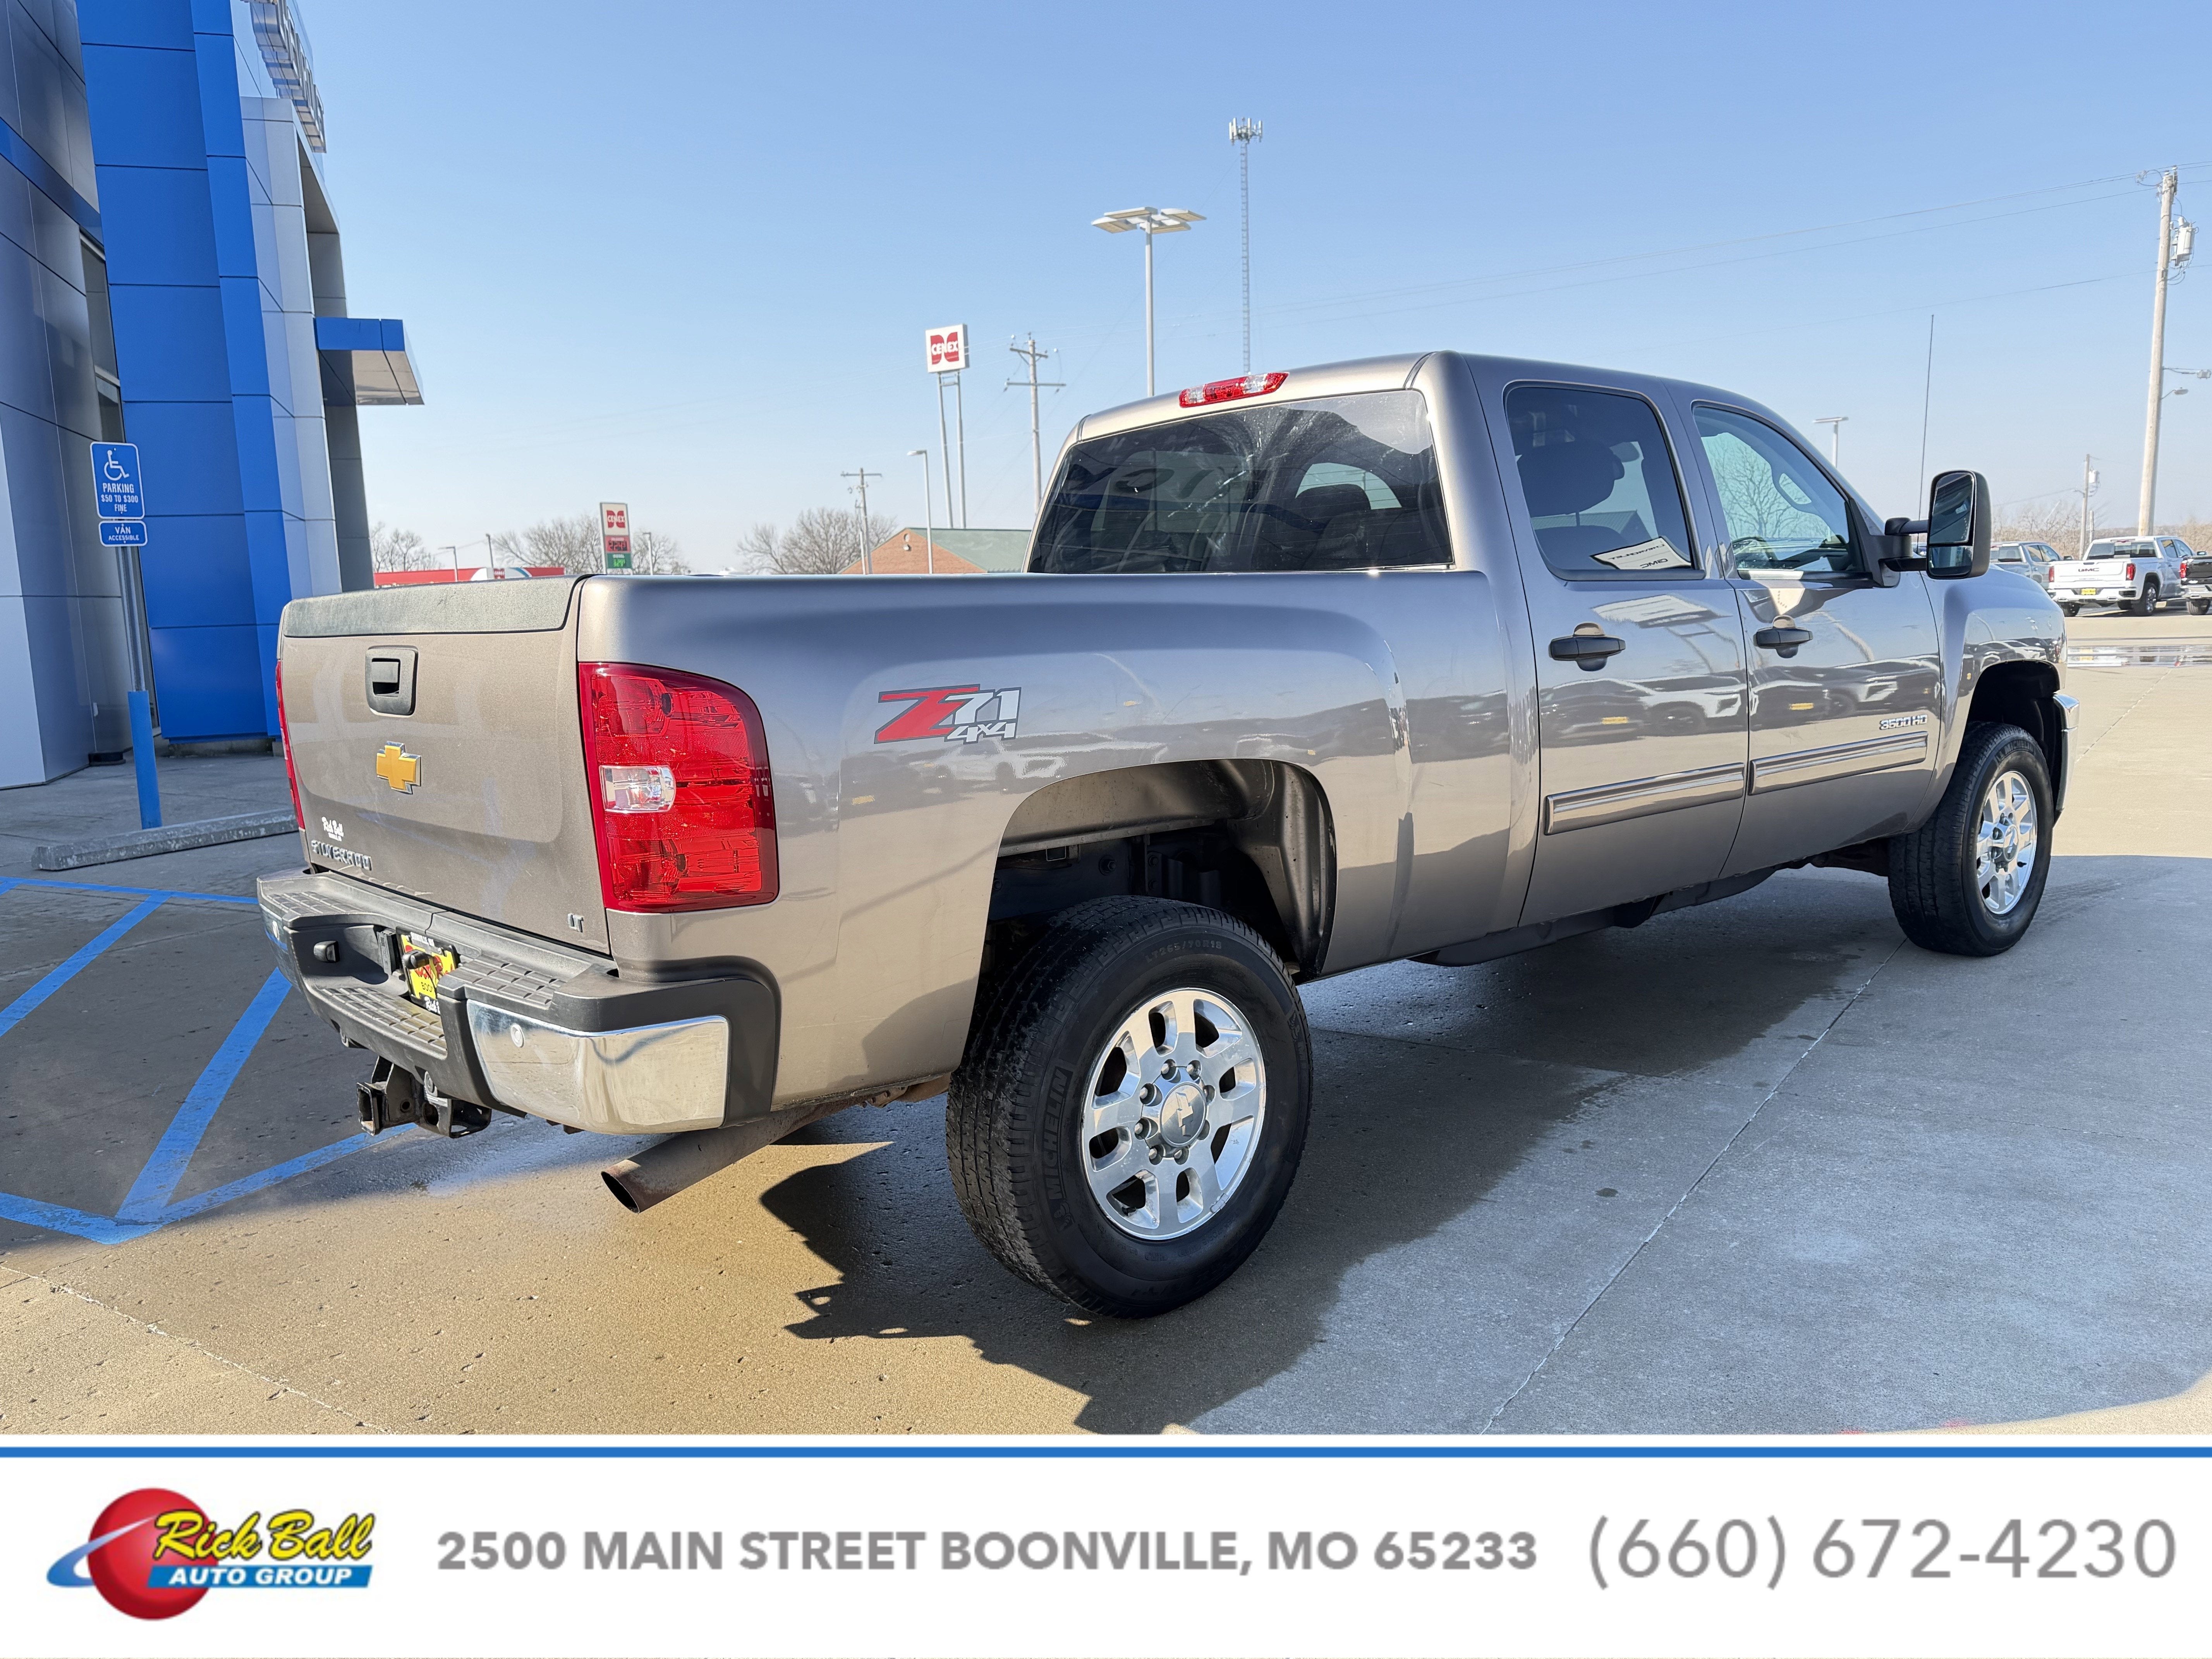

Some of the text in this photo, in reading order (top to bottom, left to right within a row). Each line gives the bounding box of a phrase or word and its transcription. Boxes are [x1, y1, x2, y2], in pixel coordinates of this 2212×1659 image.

[103, 483, 134, 493] PARKING
[101, 494, 113, 502] $50
[124, 495, 138, 503] $300
[114, 504, 127, 512] FINE
[115, 526, 131, 534] VAN
[874, 684, 1022, 744] Z71
[311, 840, 373, 871] SILVERADO
[567, 912, 584, 933] LT
[1043, 1068, 1070, 1200] MICHELIN
